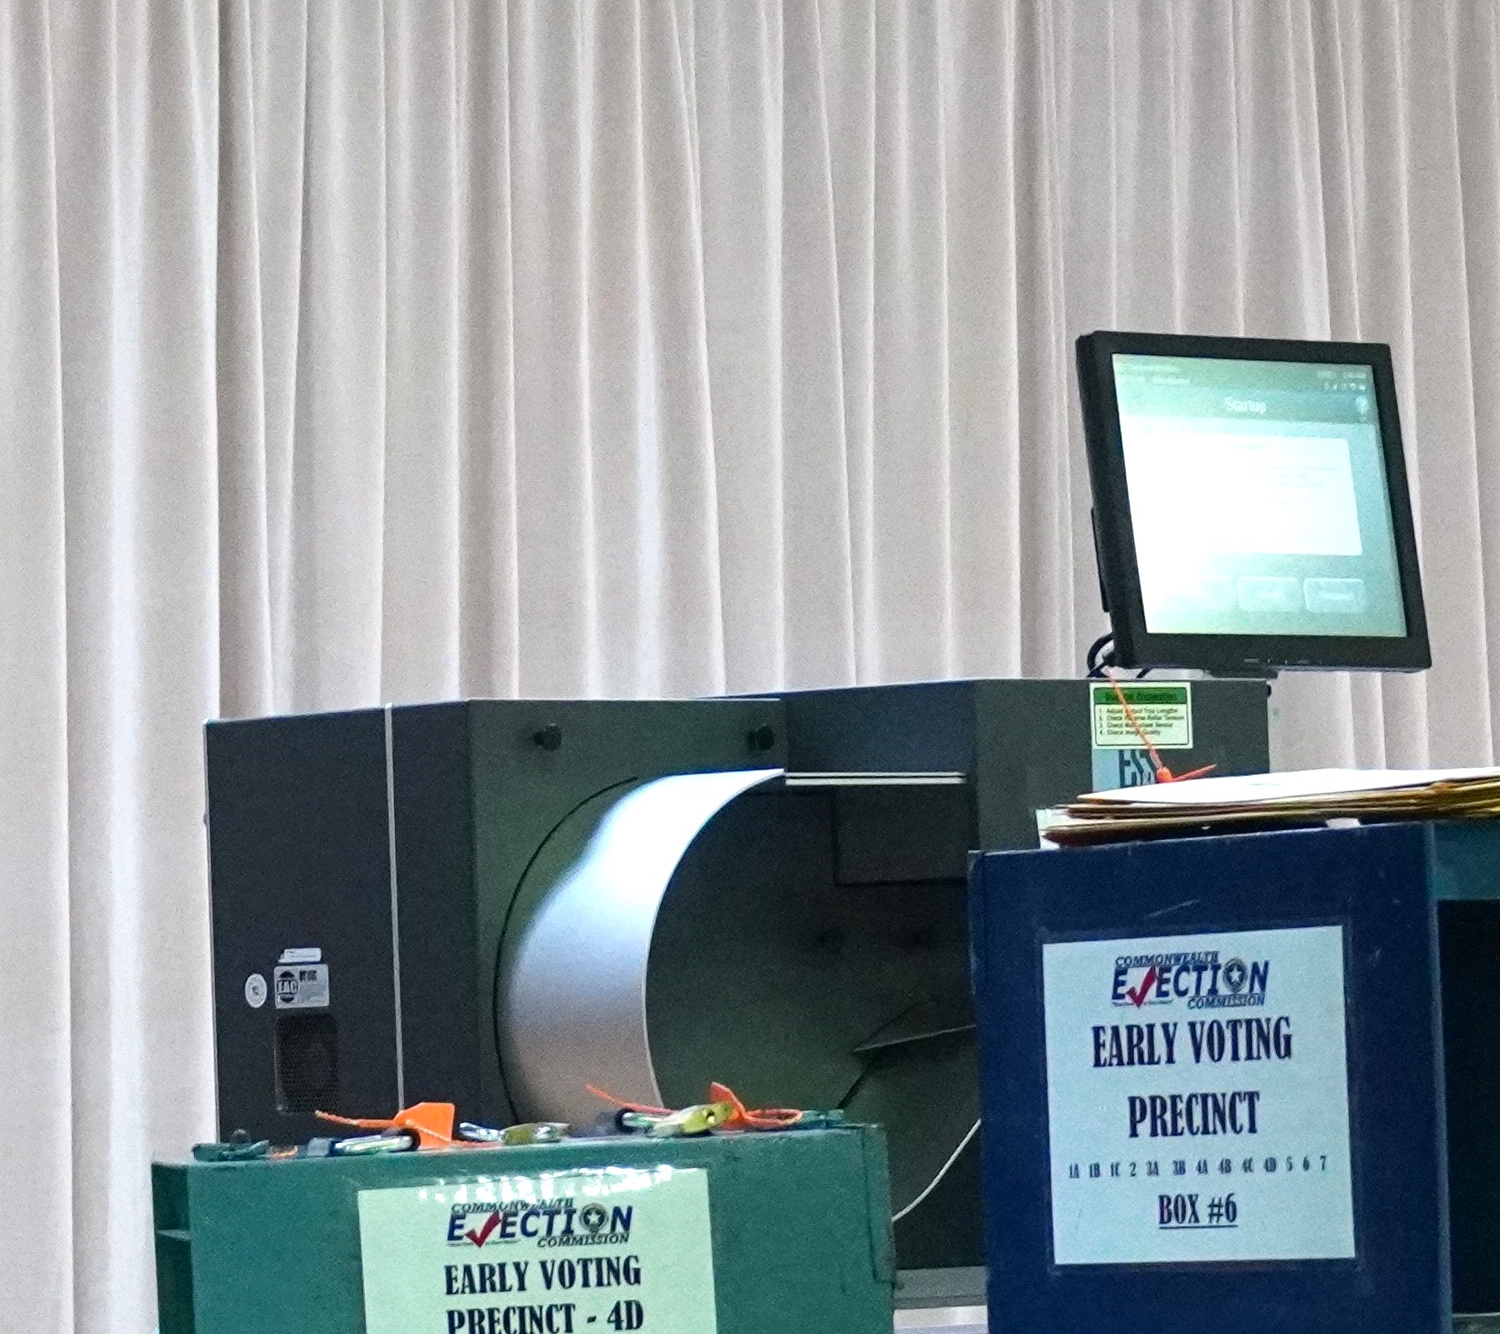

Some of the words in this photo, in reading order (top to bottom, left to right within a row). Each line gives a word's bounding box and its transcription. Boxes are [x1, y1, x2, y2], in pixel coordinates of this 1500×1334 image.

[1115, 951, 1220, 968] COMMONWEALTH
[1187, 993, 1266, 1009] COMMISSION
[1091, 1021, 1178, 1068] EARLY
[1187, 1016, 1292, 1064] VOTING
[1127, 1091, 1260, 1138] PRECINCT
[1068, 1163, 1080, 1179] 1A
[1088, 1163, 1101, 1178] 1B
[1129, 1162, 1137, 1177] 2
[1146, 1161, 1160, 1177] 3A
[1195, 1159, 1208, 1175] 4A
[1218, 1159, 1232, 1174] 4B
[1286, 1156, 1293, 1172] 5
[1302, 1155, 1310, 1171] 6
[1319, 1155, 1327, 1171] 7
[1158, 1193, 1200, 1225] BOX
[1207, 1192, 1238, 1225] #6
[537, 1232, 630, 1248] COMMISSION
[444, 1259, 529, 1295] EARLY
[539, 1255, 642, 1291] VOTING
[606, 1299, 644, 1332] 4D
